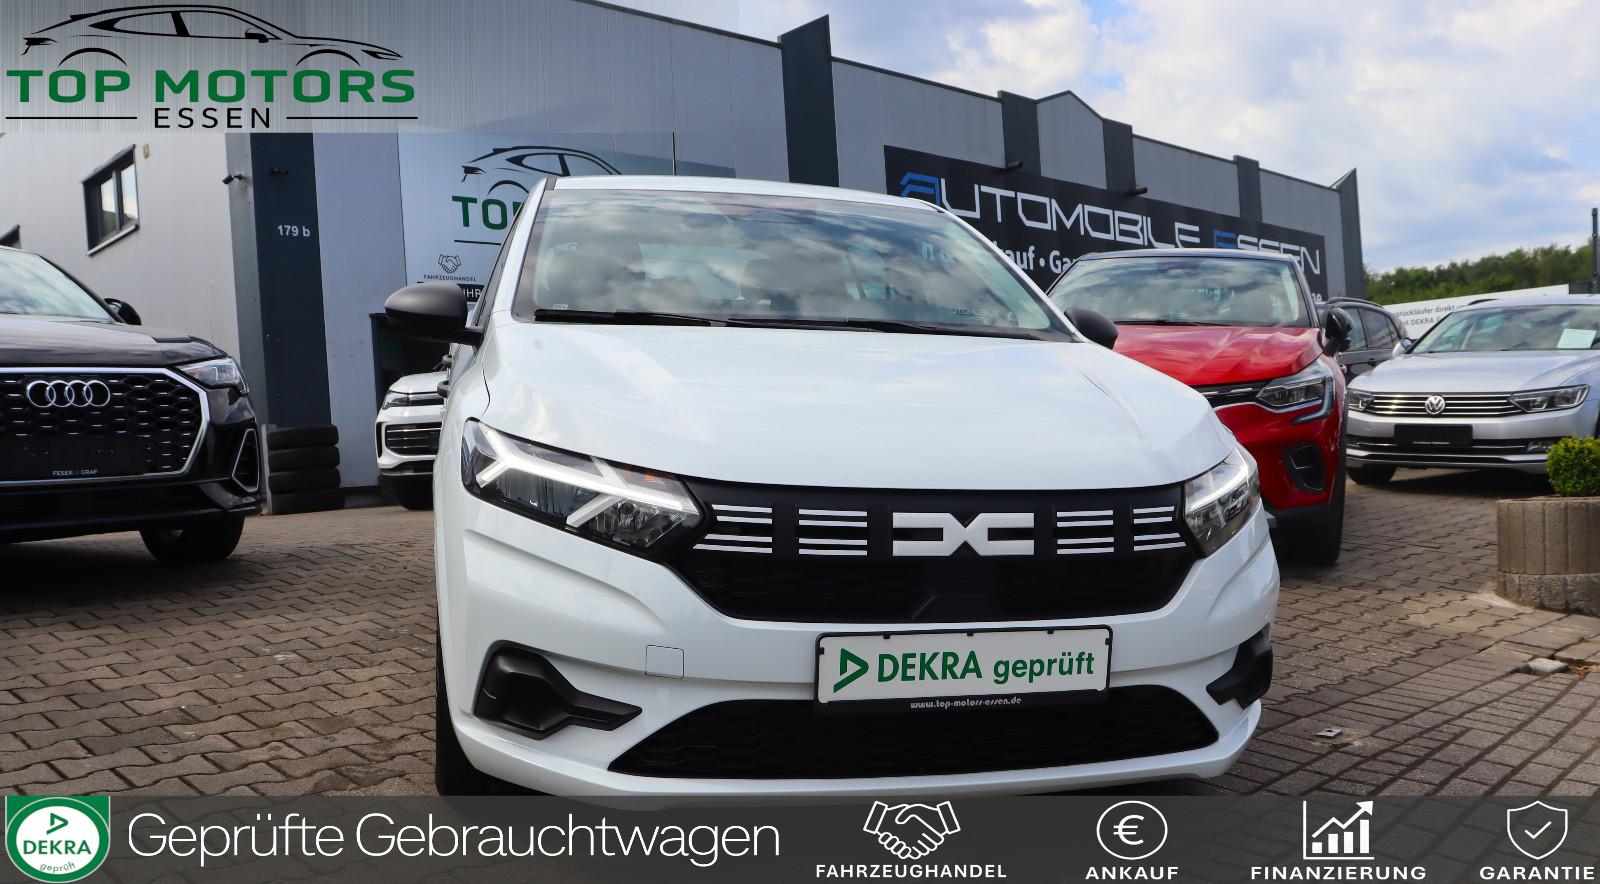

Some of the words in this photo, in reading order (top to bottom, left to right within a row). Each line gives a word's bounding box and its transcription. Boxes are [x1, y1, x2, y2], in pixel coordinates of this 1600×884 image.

[900, 172, 1201, 249] AUTOMOBILE
[277, 224, 299, 237] 179
[302, 225, 311, 237] b
[423, 274, 477, 283] FAHRZEUGHANDEL
[1435, 305, 1455, 313] direkt
[1411, 317, 1435, 326] DEKRA
[80, 468, 98, 476] GRAF
[877, 650, 983, 682] DEKRA
[993, 651, 1095, 684] geprüft
[910, 696, 1022, 709] www.top-motors-essen.de
